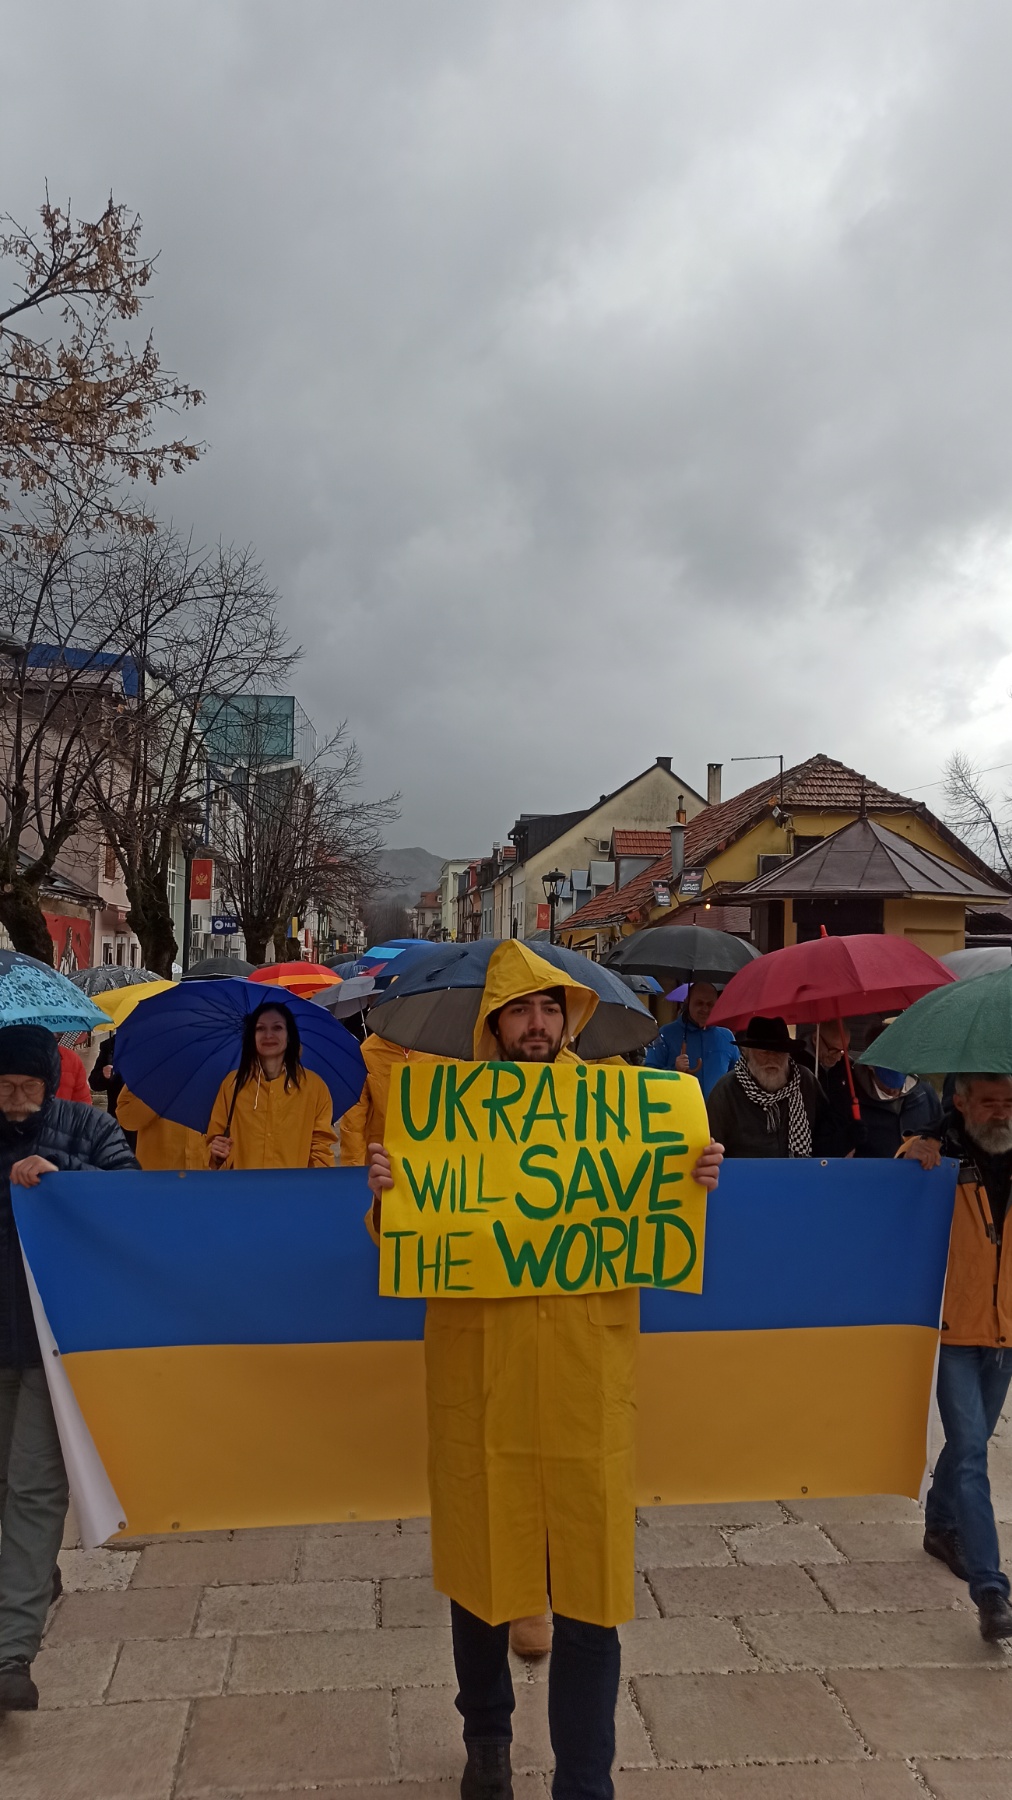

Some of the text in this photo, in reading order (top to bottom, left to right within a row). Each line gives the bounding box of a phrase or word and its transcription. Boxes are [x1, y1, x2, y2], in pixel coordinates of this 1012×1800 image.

[402, 1144, 688, 1220] WILL SAVE
[383, 1213, 697, 1294] THE WORLD
